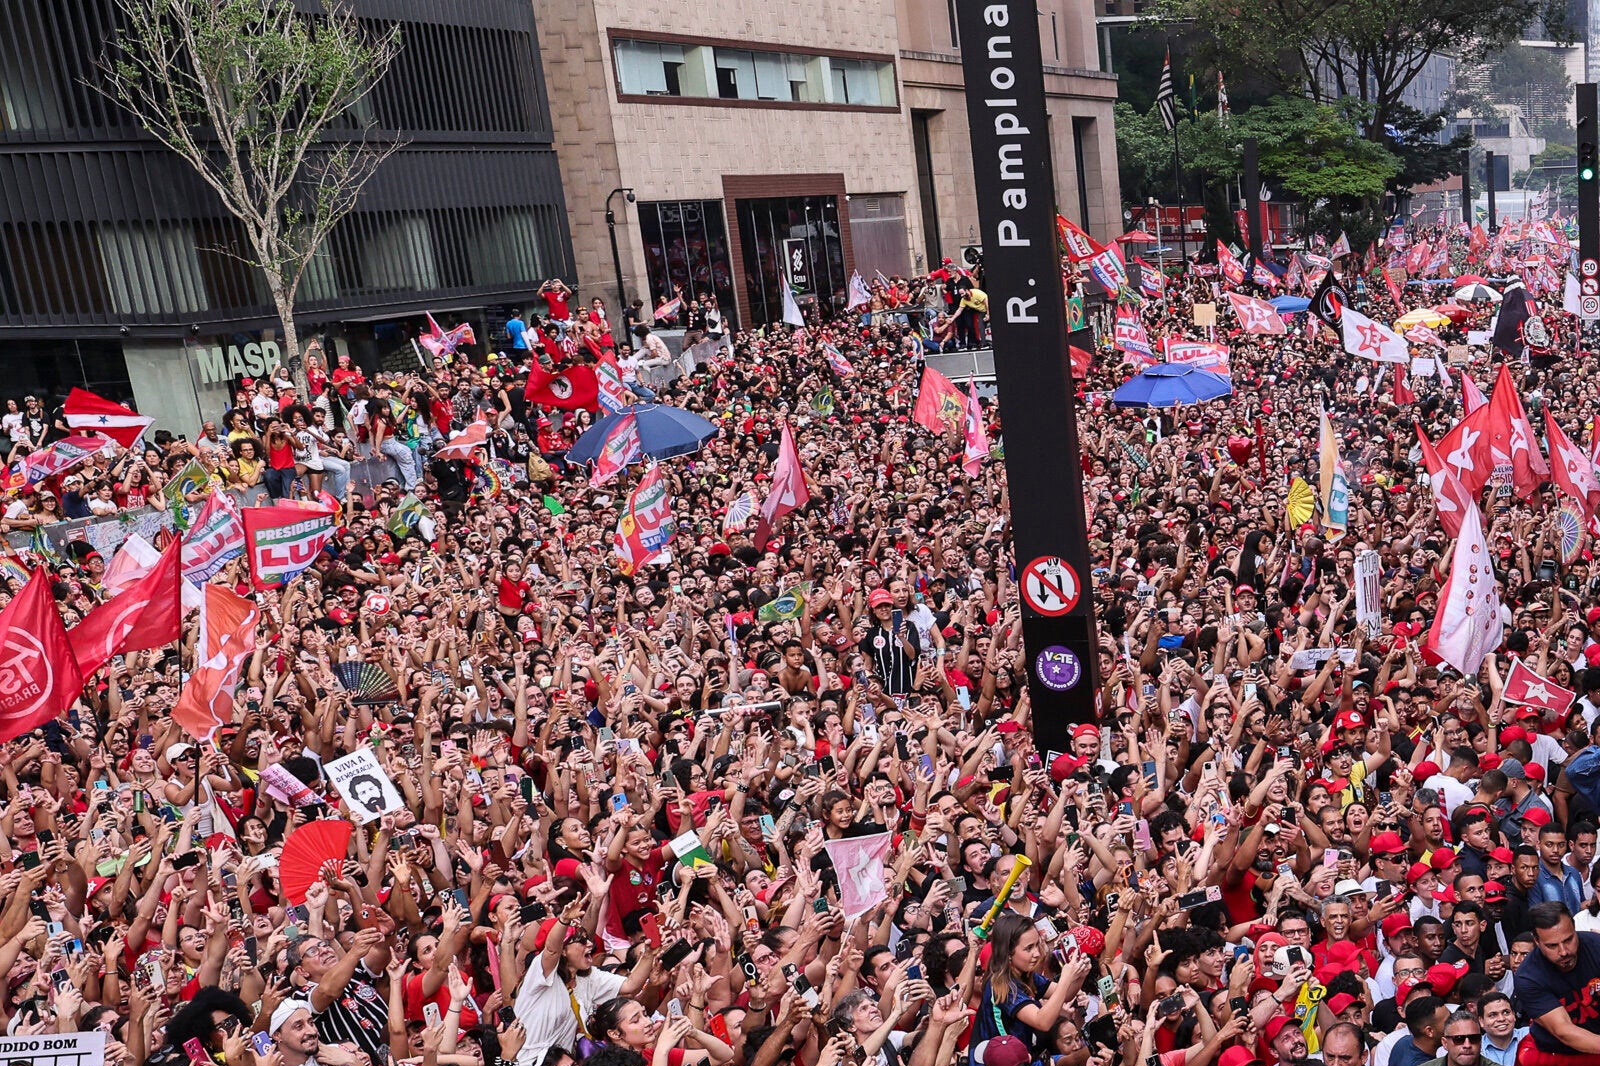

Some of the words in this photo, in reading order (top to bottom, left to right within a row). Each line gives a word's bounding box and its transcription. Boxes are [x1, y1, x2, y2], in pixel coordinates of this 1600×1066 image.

[984, 4, 1031, 247] Pamplona
[1584, 262, 1596, 271] 50
[1006, 279, 1039, 323] R.
[1585, 300, 1596, 309] 20
[1248, 304, 1265, 322] 13
[1365, 329, 1381, 347] 13
[195, 341, 283, 384] MASP
[256, 515, 332, 541] PRESIDENTE
[1038, 662, 1048, 683] PARTIDO
[334, 760, 355, 773] VIVA
[358, 755, 366, 764] A
[336, 763, 374, 782] DEMOCRACIA
[43, 1037, 78, 1052] BOM
